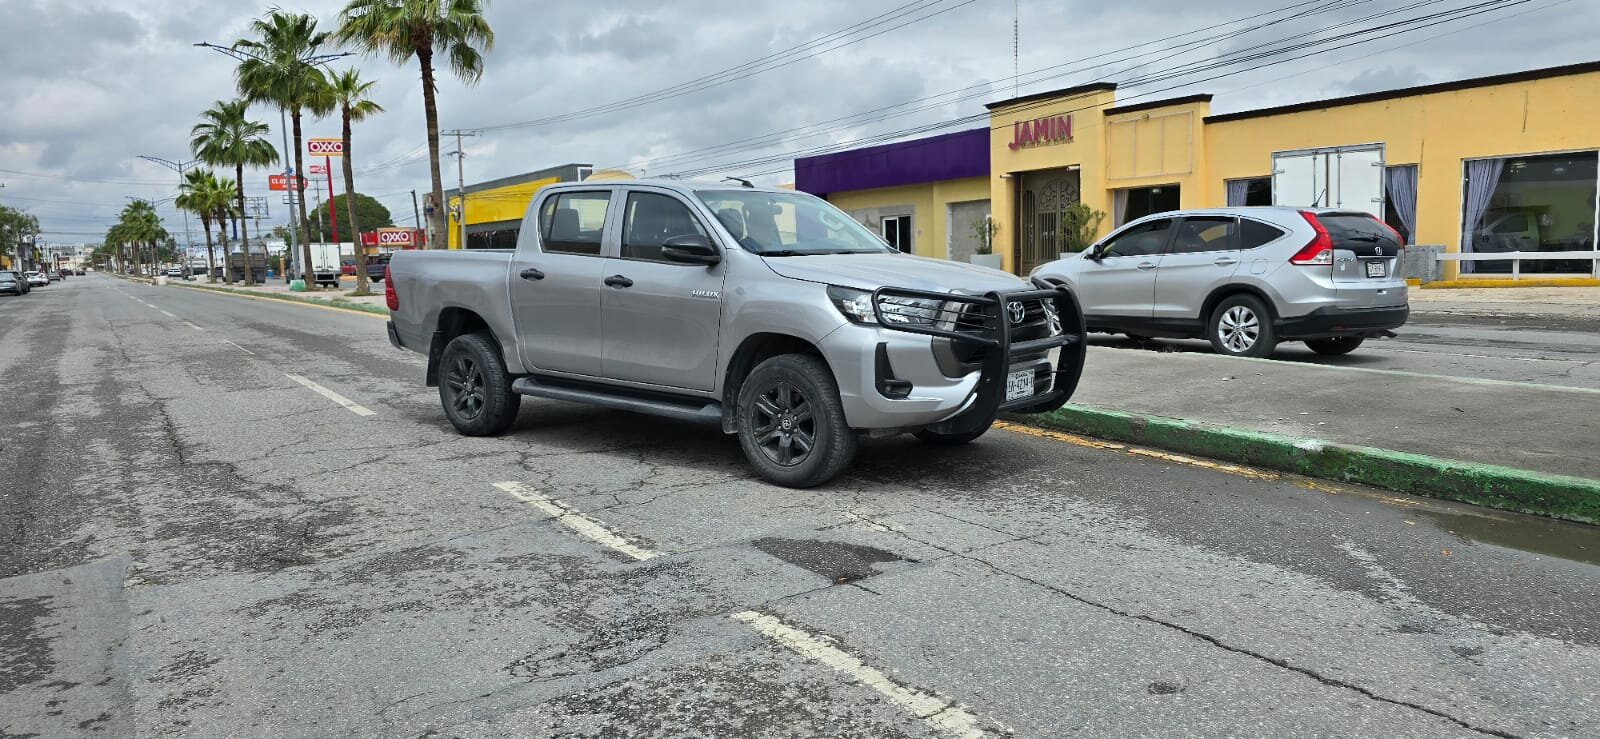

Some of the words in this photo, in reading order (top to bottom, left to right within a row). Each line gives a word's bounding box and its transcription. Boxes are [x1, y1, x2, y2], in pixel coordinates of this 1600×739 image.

[1008, 114, 1074, 150] JAMIN
[310, 142, 343, 153] OXXO
[381, 232, 409, 242] OXXO
[692, 289, 719, 298] HILUX
